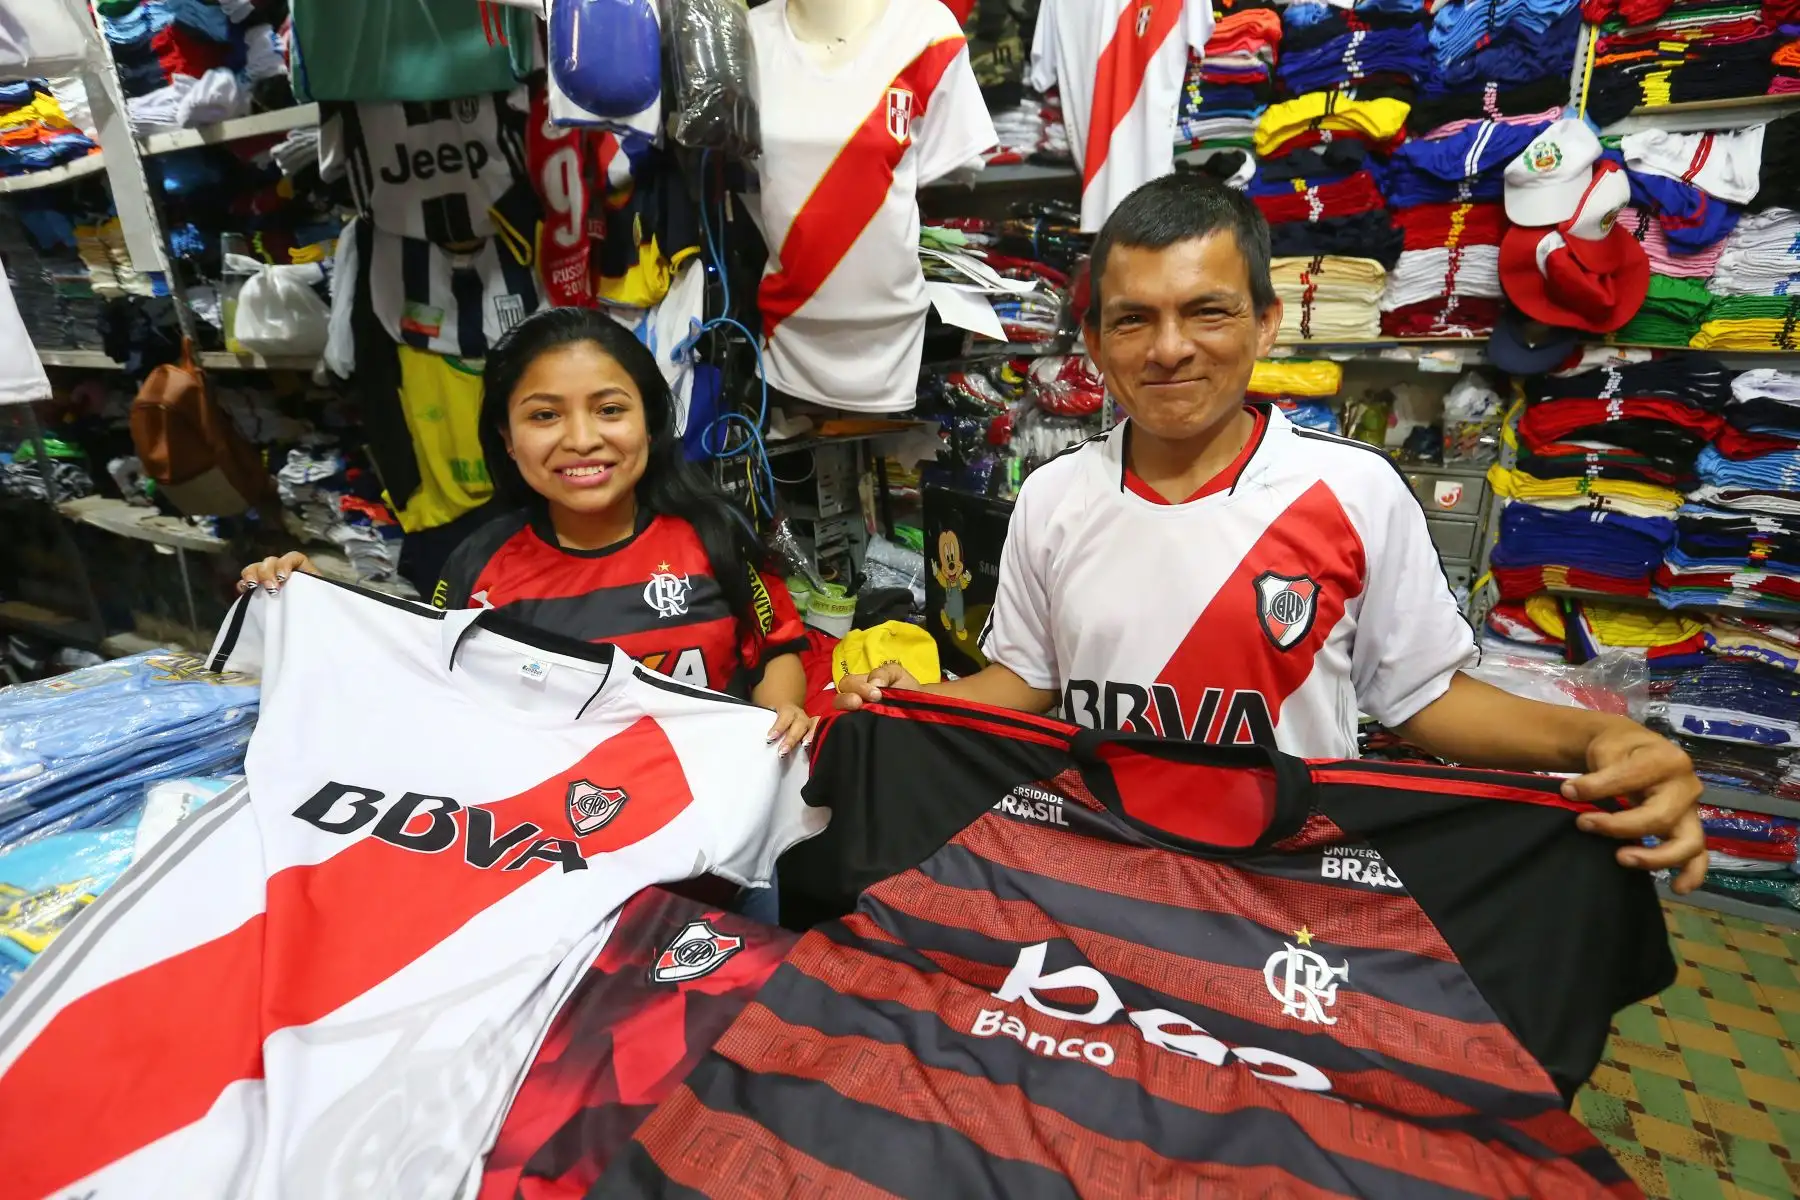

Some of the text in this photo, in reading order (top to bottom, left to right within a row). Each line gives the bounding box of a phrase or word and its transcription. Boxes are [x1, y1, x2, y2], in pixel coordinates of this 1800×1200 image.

[380, 139, 489, 185] Jeep
[541, 146, 584, 248] 9
[1063, 678, 1280, 750] BBVA
[291, 780, 589, 874] BBVA
[971, 1008, 1116, 1067] Banco
